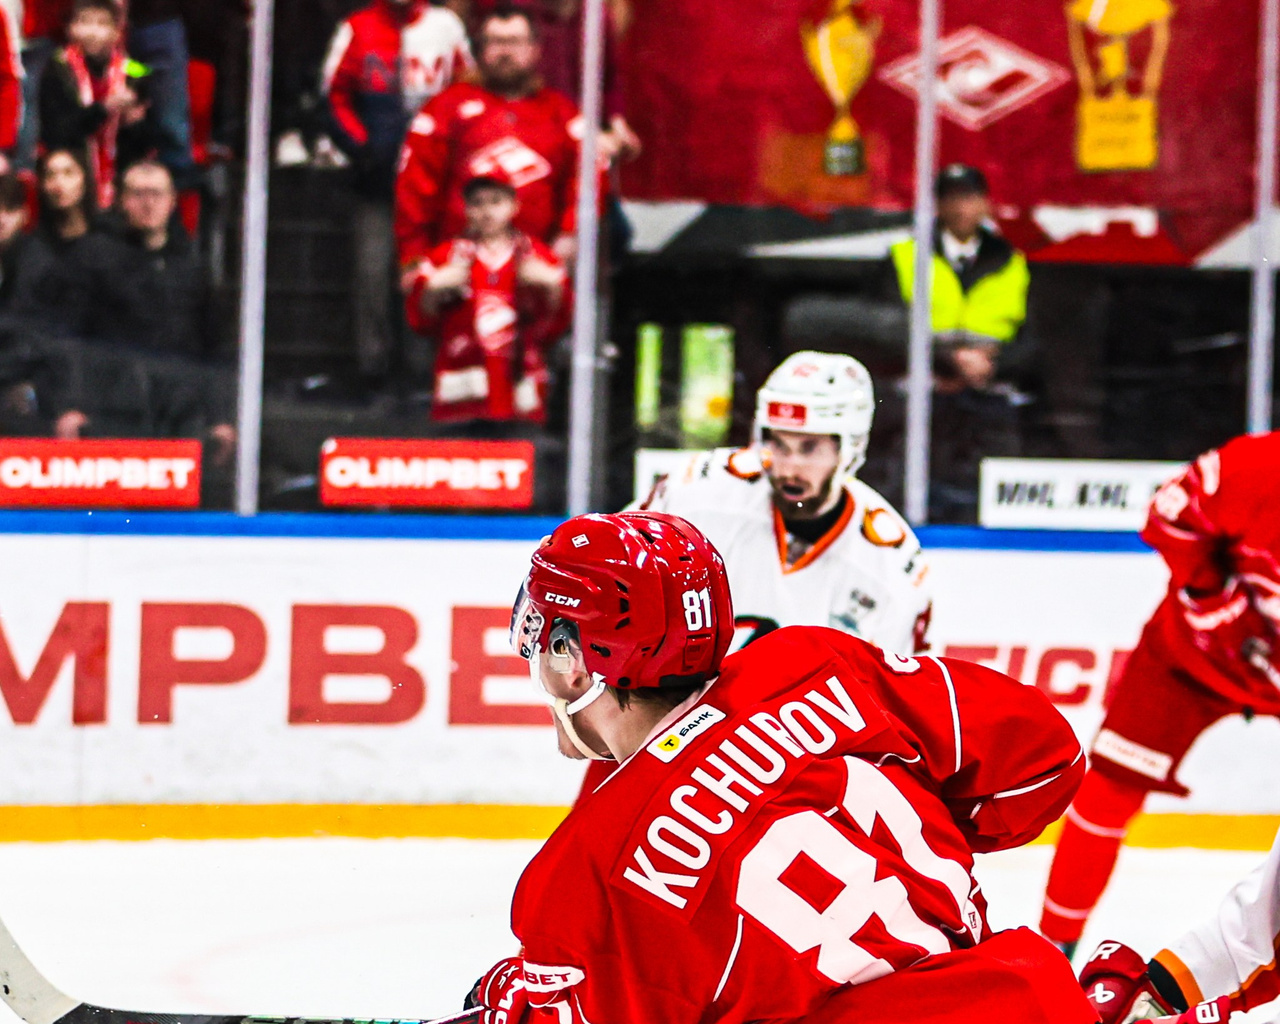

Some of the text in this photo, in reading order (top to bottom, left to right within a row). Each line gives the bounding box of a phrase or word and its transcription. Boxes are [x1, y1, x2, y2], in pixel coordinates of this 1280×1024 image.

[324, 457, 528, 490] OLIMPBET
[544, 591, 581, 608] CCM
[682, 587, 712, 631] 81
[678, 710, 713, 737] БАНК
[622, 675, 867, 909] KOCHUROV
[735, 755, 978, 985] 81
